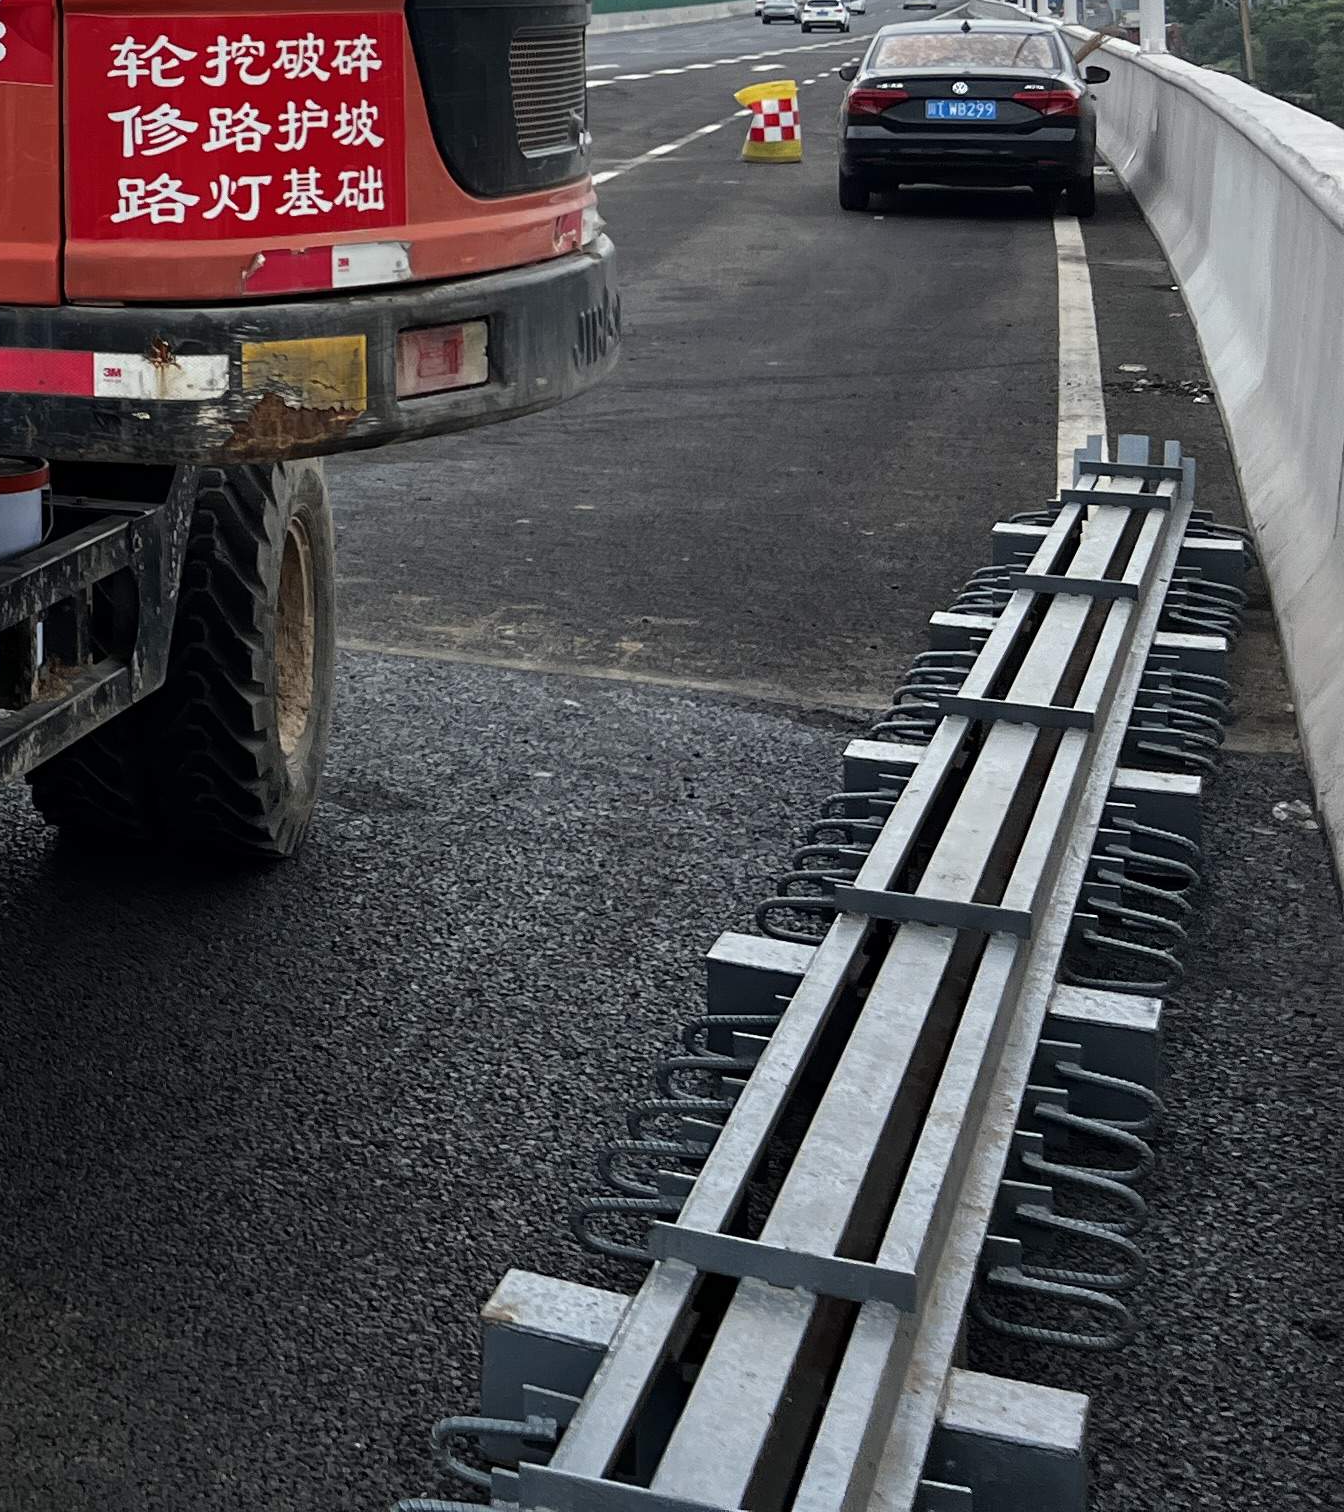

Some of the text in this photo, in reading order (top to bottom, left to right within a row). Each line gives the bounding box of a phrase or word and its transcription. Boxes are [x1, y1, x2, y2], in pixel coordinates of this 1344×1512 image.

[107, 32, 383, 89] 轮挖破碎
[107, 99, 384, 159] 修路护坡
[109, 165, 385, 225] 路灯基础
[103, 367, 122, 378] 3M
